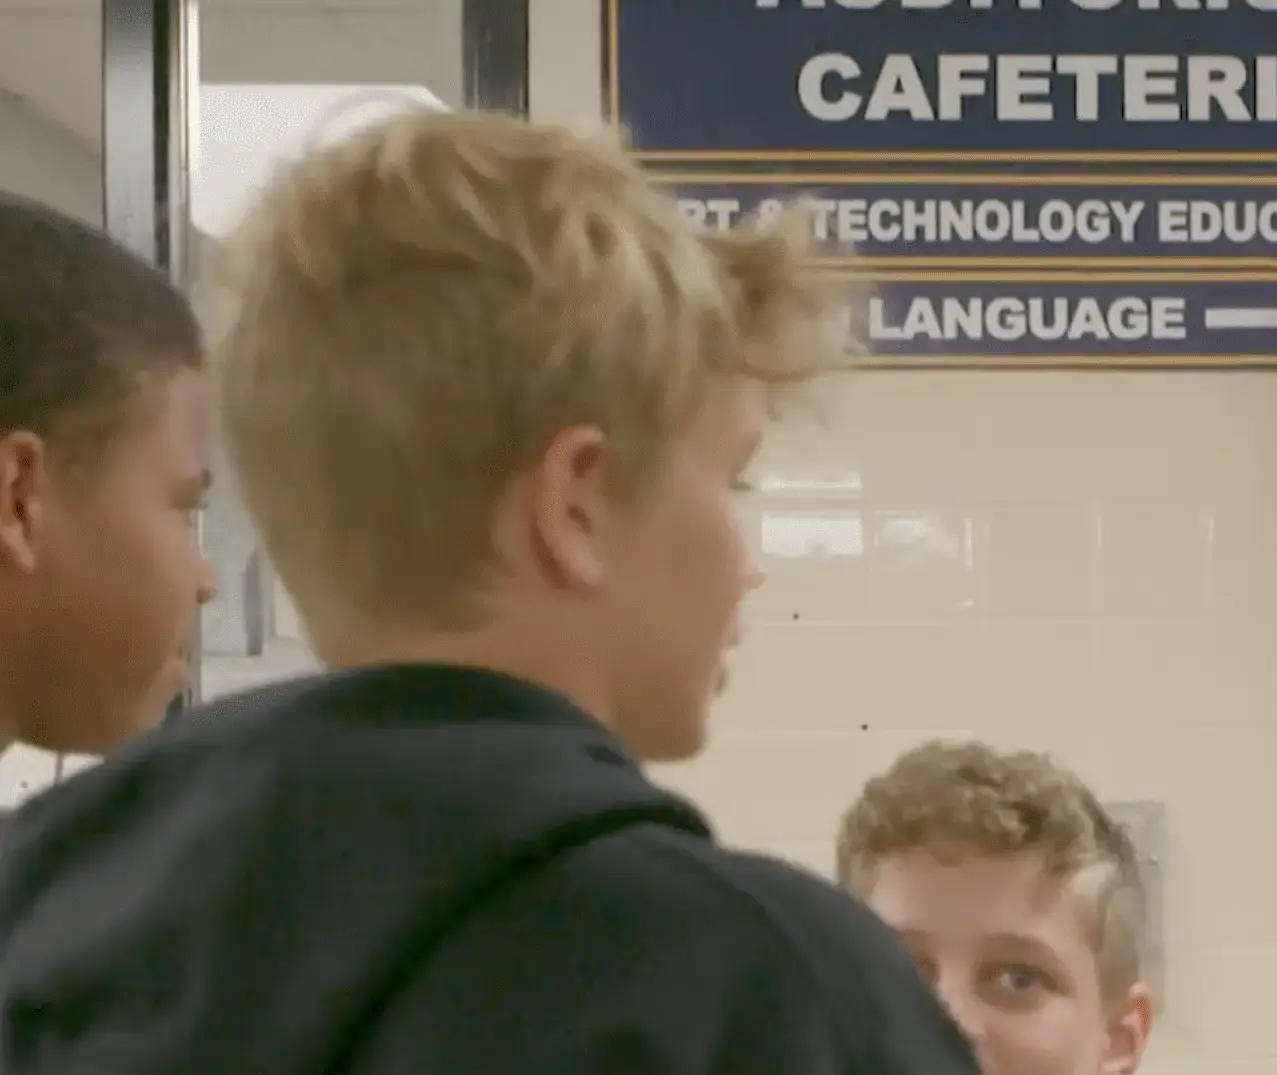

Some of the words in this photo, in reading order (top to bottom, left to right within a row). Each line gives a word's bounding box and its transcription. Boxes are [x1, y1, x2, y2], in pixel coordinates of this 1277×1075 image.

[677, 198, 741, 236] RT
[810, 199, 1145, 242] TECHNOLOGY
[869, 296, 1186, 340] LANGUAGE
